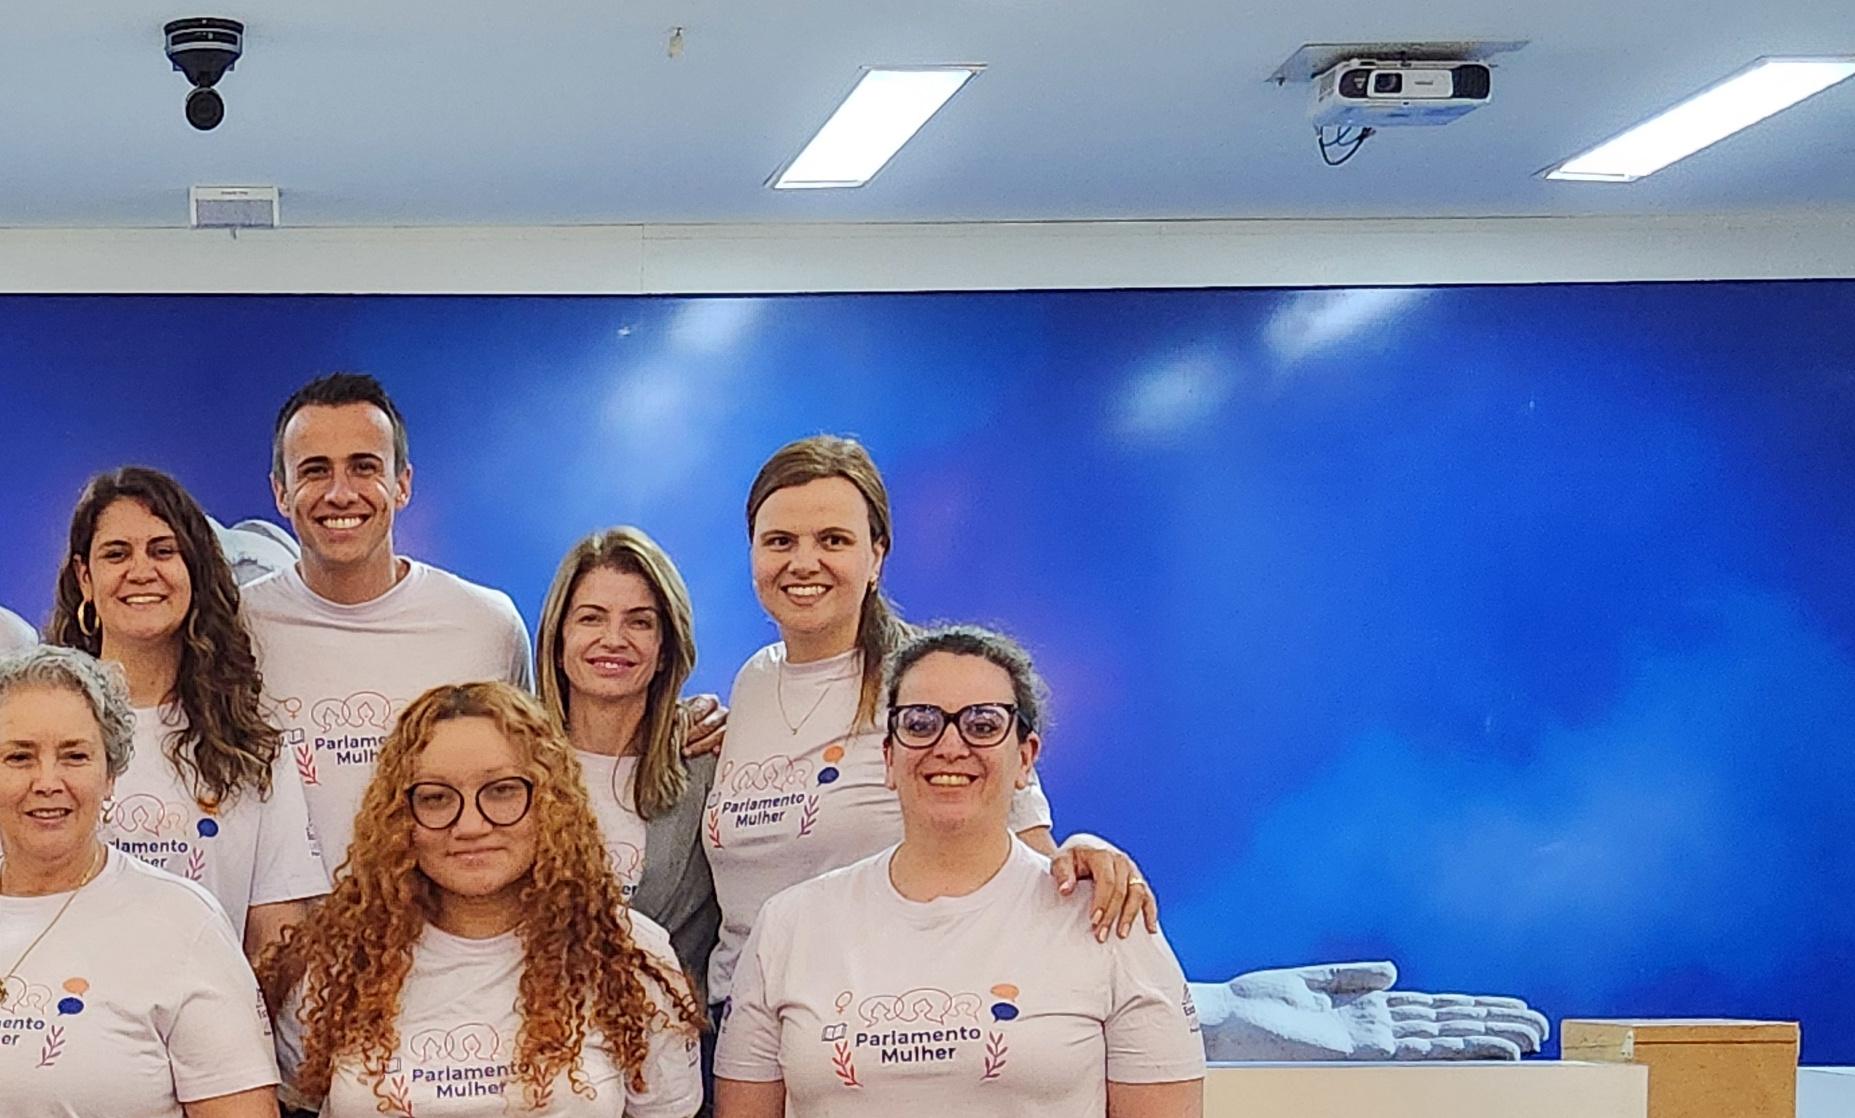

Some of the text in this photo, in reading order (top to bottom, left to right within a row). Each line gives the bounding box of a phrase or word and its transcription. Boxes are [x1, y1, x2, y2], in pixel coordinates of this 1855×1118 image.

[721, 793, 805, 815] Parlamento
[735, 811, 785, 828] Mulher
[855, 1026, 981, 1048] Parlamento
[881, 1046, 956, 1064] Mulher
[411, 1061, 530, 1083] Parlamento
